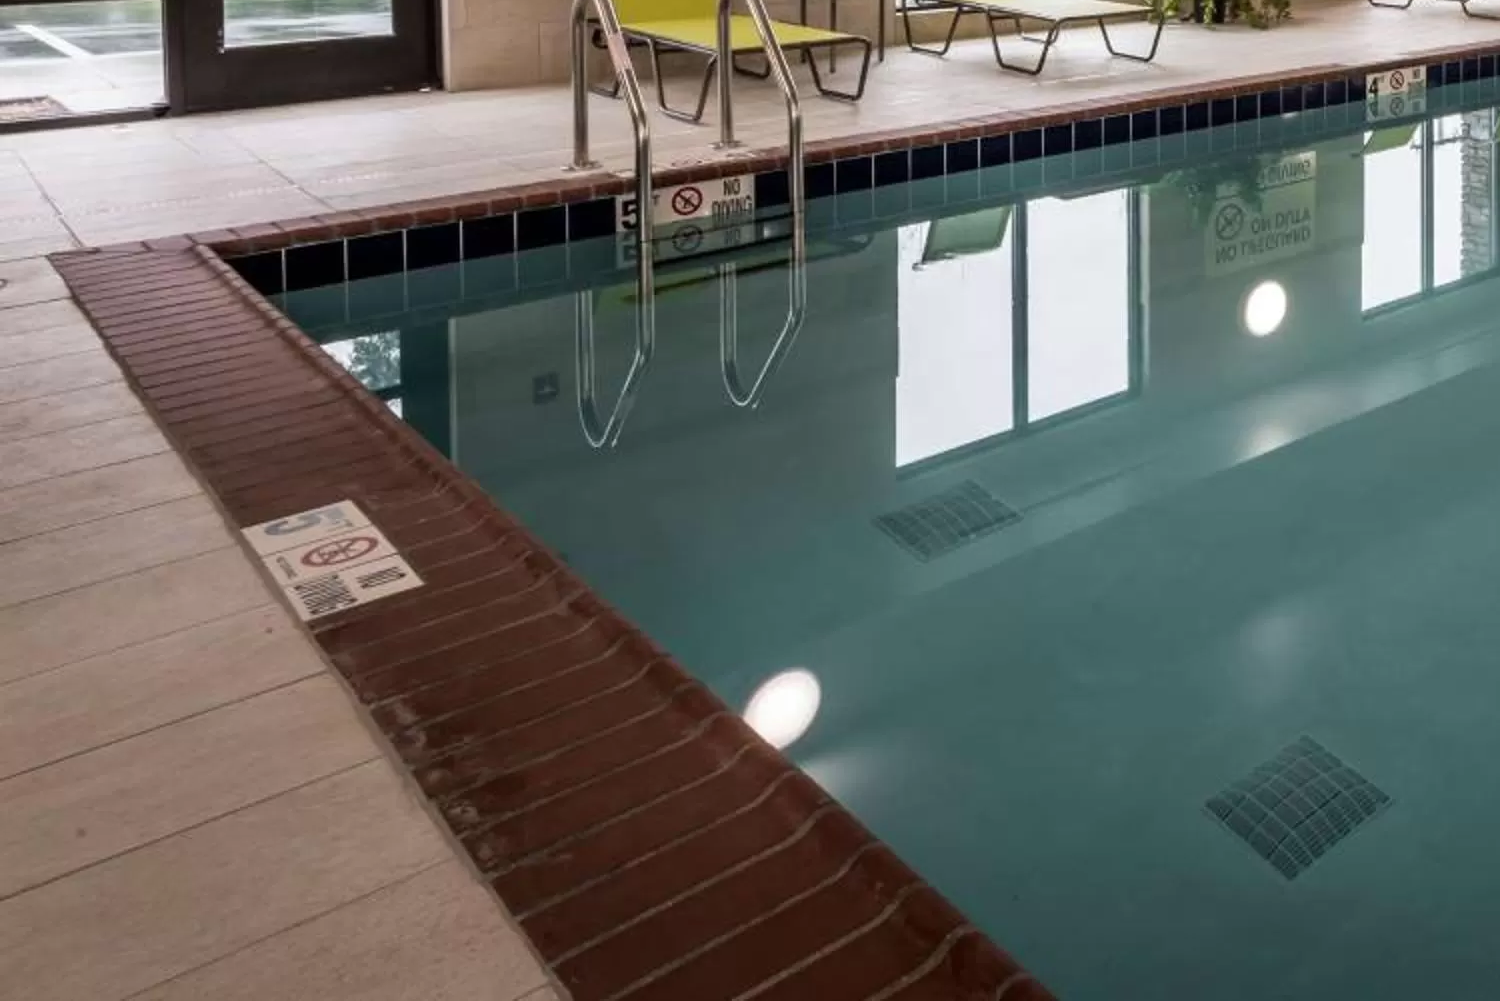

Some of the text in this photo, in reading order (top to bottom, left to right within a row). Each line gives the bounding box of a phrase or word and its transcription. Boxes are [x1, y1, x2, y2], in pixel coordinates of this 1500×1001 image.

[1369, 77, 1378, 94] 4
[723, 179, 741, 196] NO
[621, 199, 638, 229] 5
